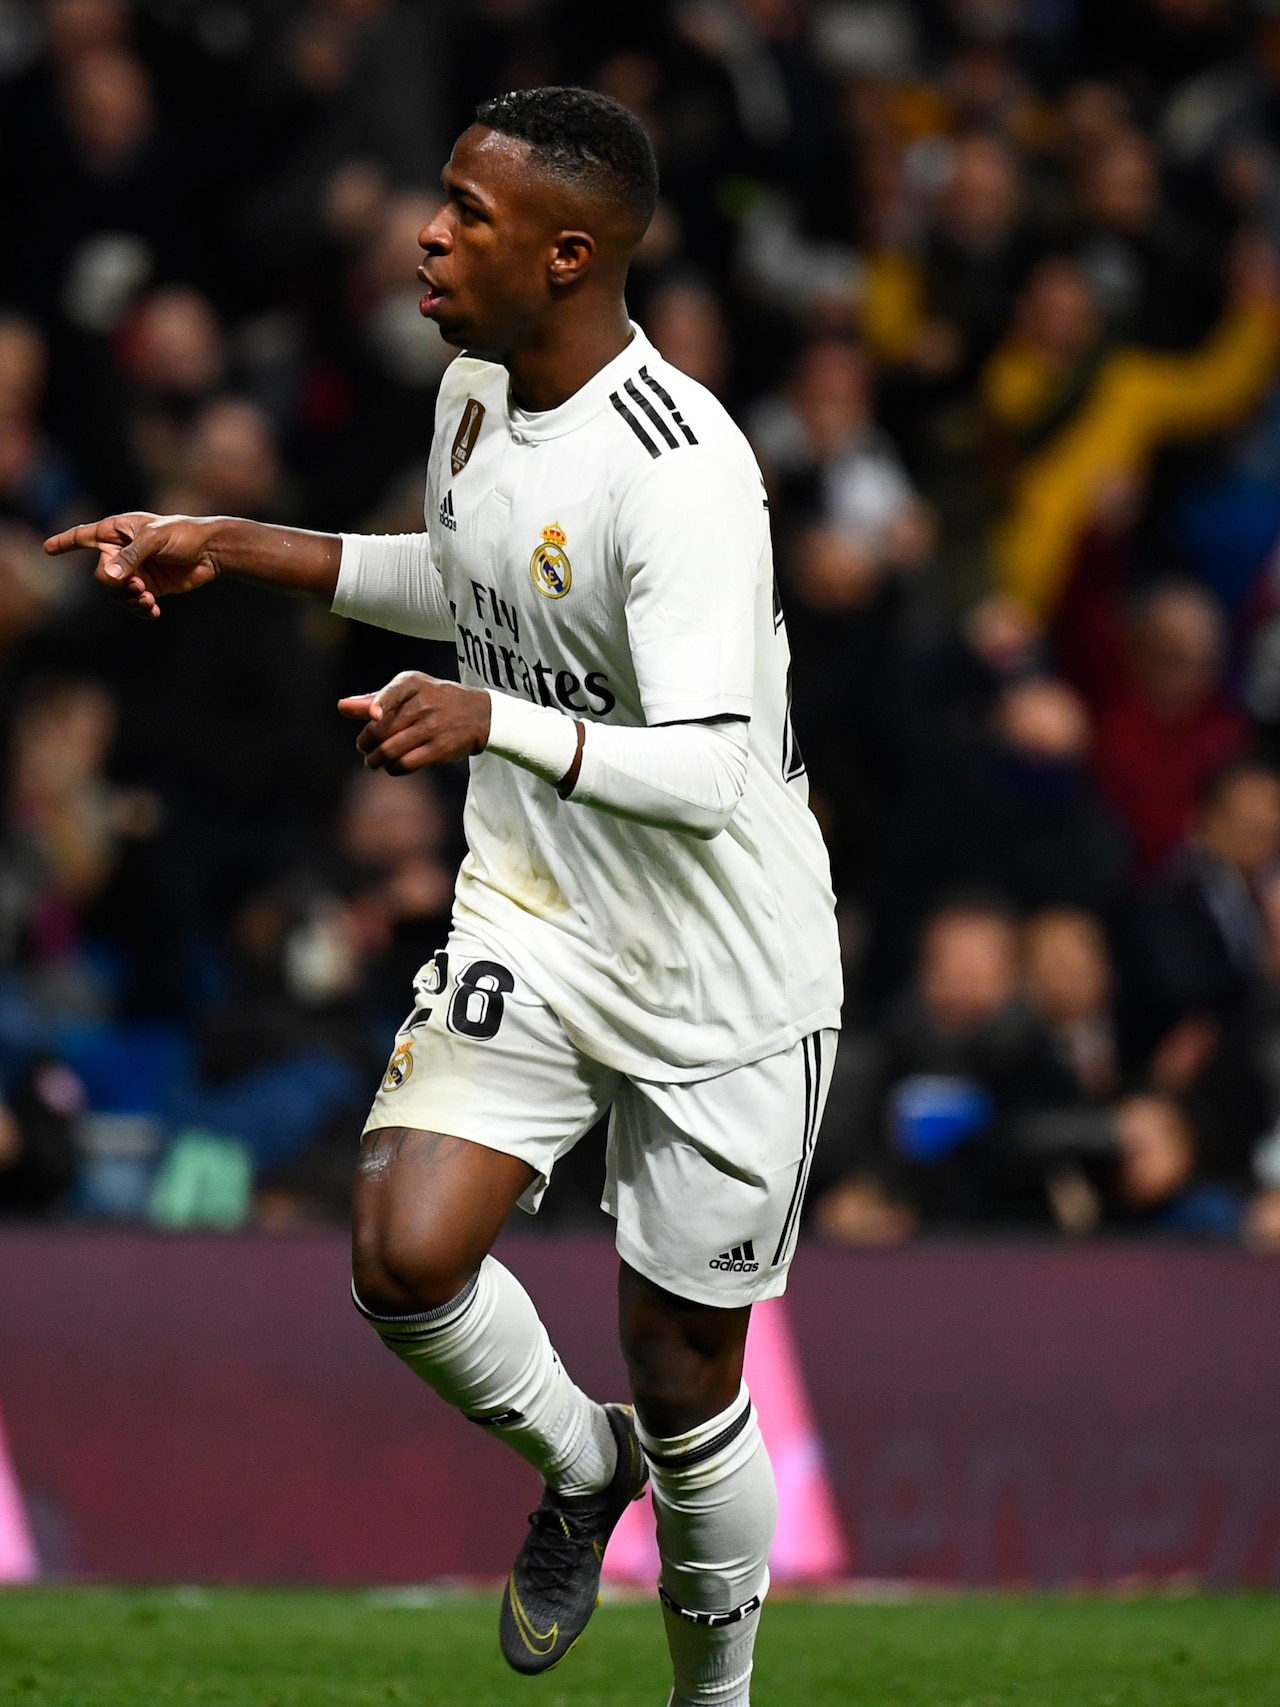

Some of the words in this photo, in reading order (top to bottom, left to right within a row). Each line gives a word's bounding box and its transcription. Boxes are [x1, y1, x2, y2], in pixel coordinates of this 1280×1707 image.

[470, 579, 520, 644] Fly
[457, 623, 616, 717] mirates
[708, 1258, 760, 1273] adidas
